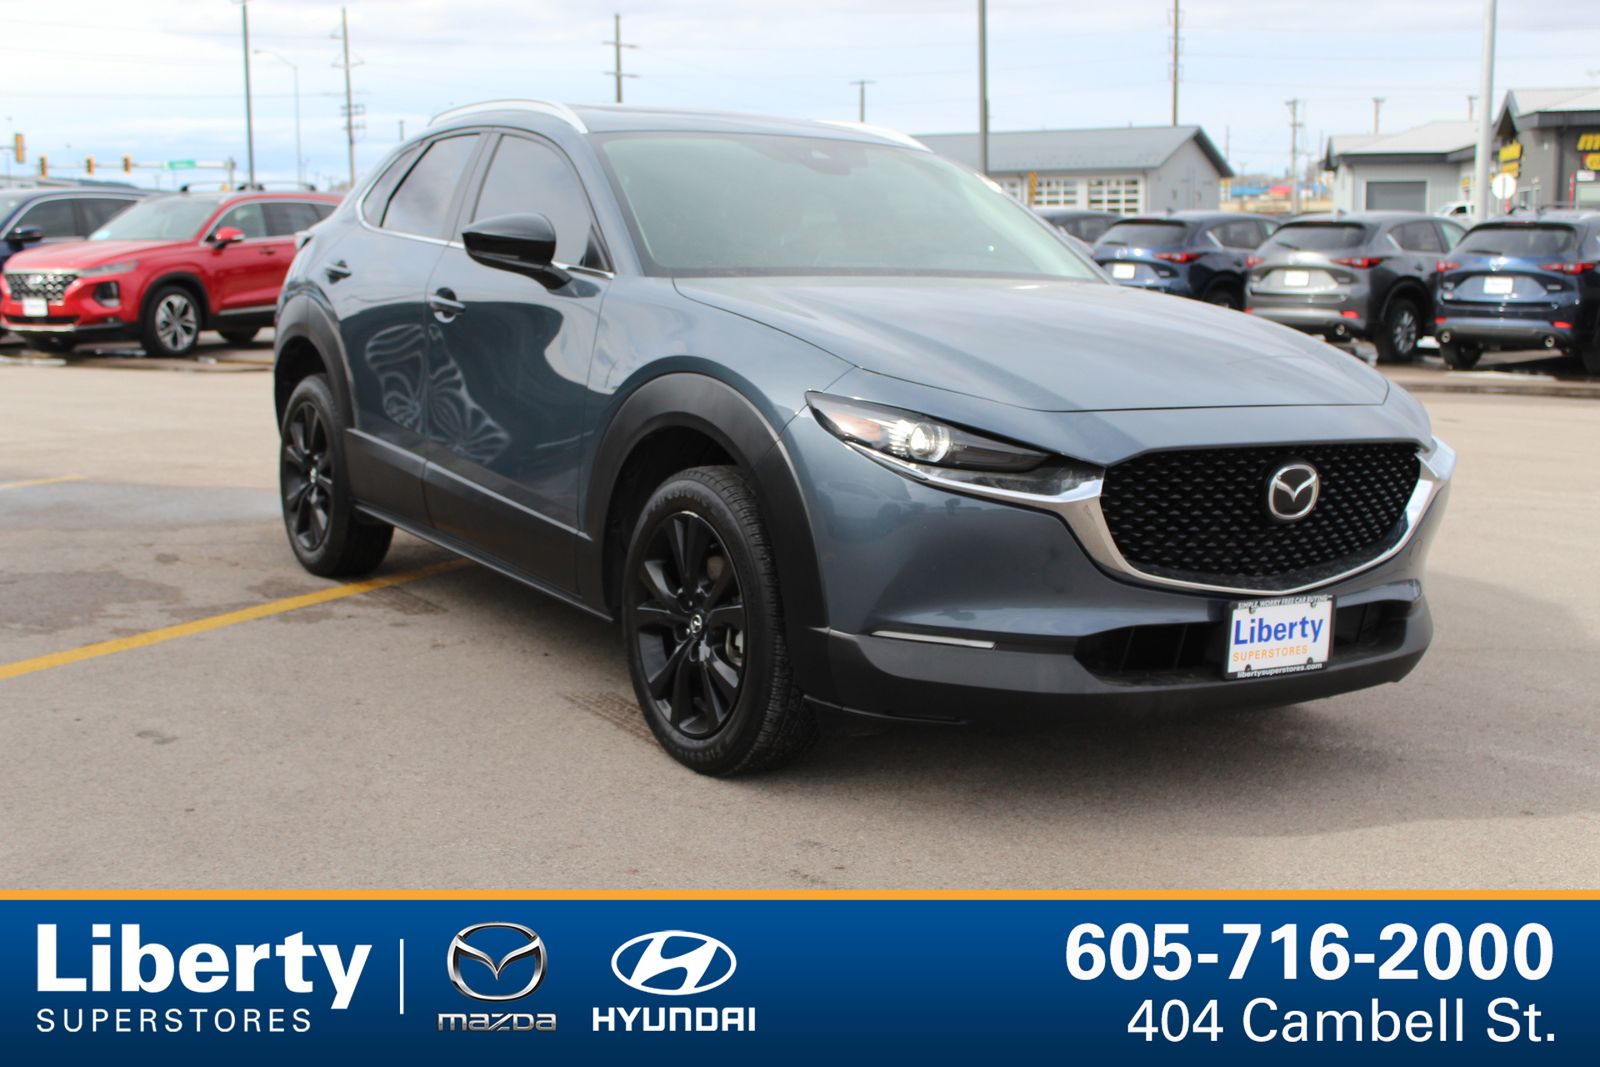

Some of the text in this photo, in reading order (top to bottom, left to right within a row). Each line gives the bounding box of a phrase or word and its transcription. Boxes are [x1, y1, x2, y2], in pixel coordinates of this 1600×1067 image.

[1234, 616, 1324, 645] Liberty
[1232, 645, 1308, 662] SUPERSTORES
[1237, 663, 1323, 678] libertysuperstores.com
